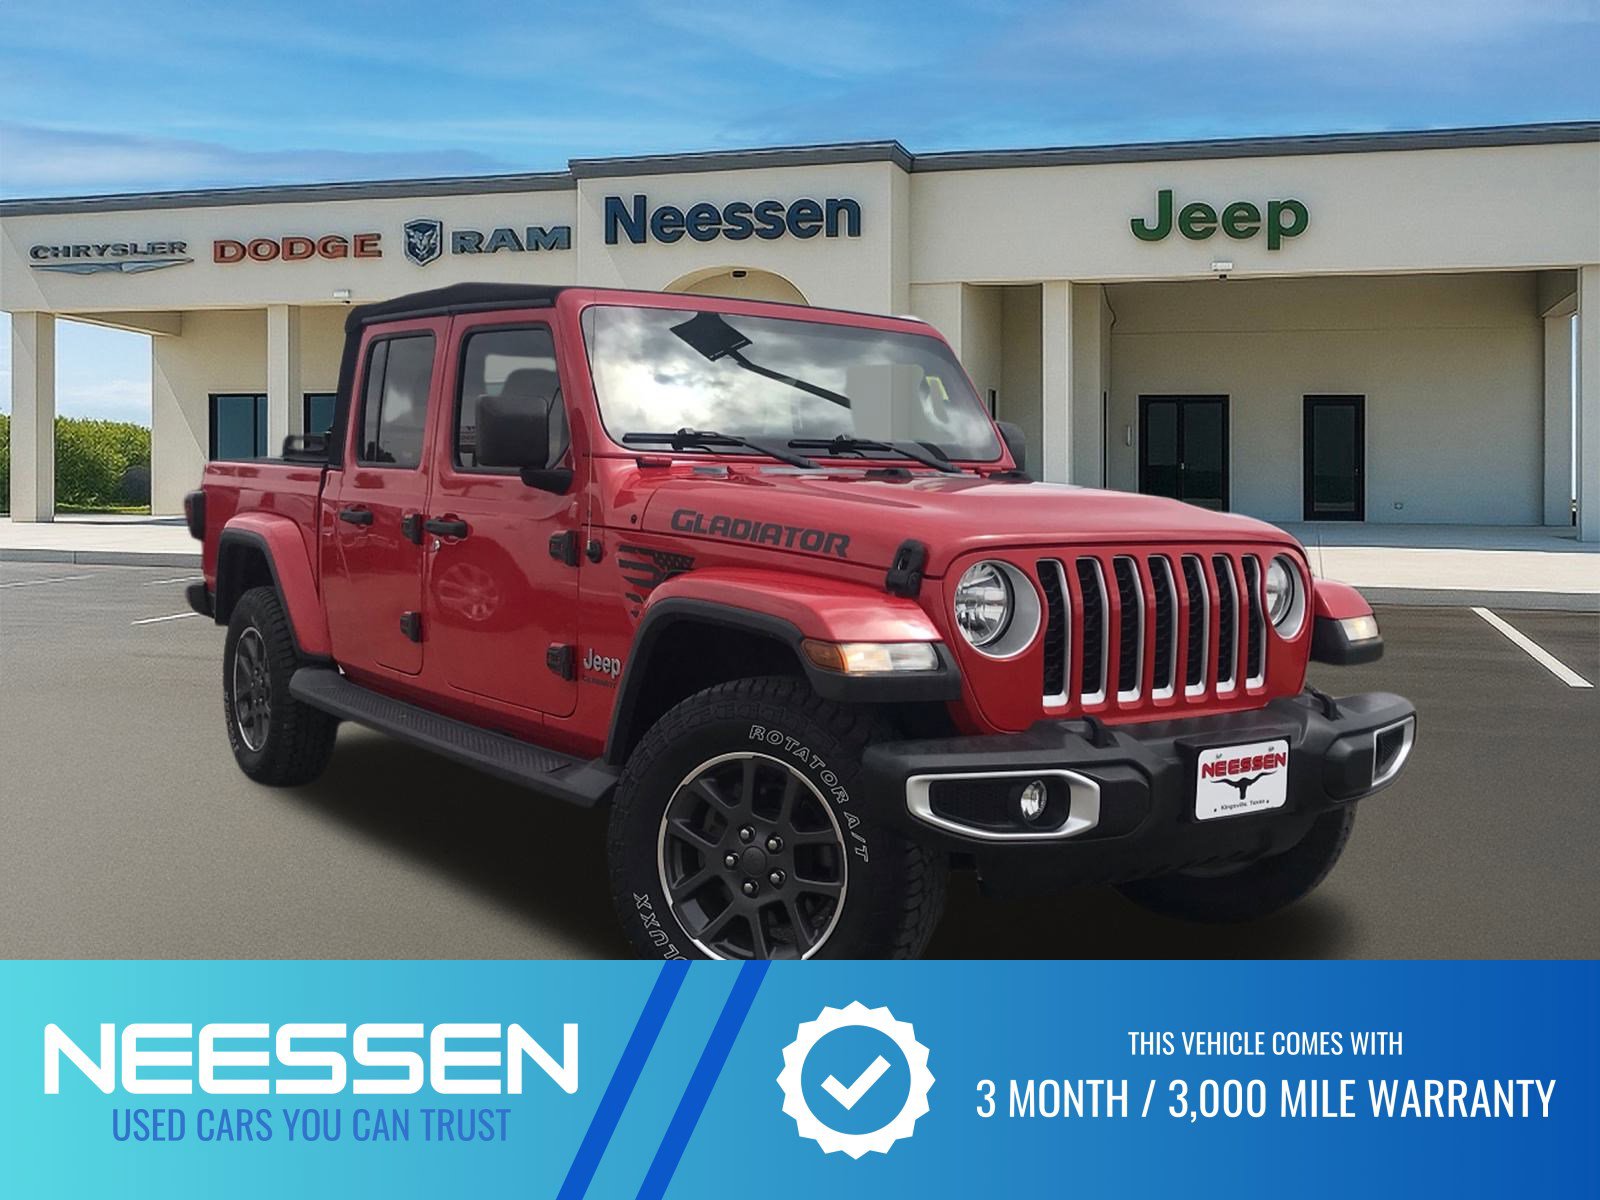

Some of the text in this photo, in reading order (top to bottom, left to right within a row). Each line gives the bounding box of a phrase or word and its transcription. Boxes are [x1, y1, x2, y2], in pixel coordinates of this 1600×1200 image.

[604, 194, 862, 245] Neessen
[1130, 190, 1309, 250] Jeep
[30, 240, 188, 259] CHRYSLER
[213, 233, 382, 264] DODGE
[452, 226, 571, 254] RAM
[671, 508, 850, 557] GLADIATOR
[583, 647, 621, 679] Jeep
[1201, 752, 1287, 780] NEESSEN
[749, 724, 869, 863] ROTATOR A/T
[632, 892, 689, 960] LUXX
